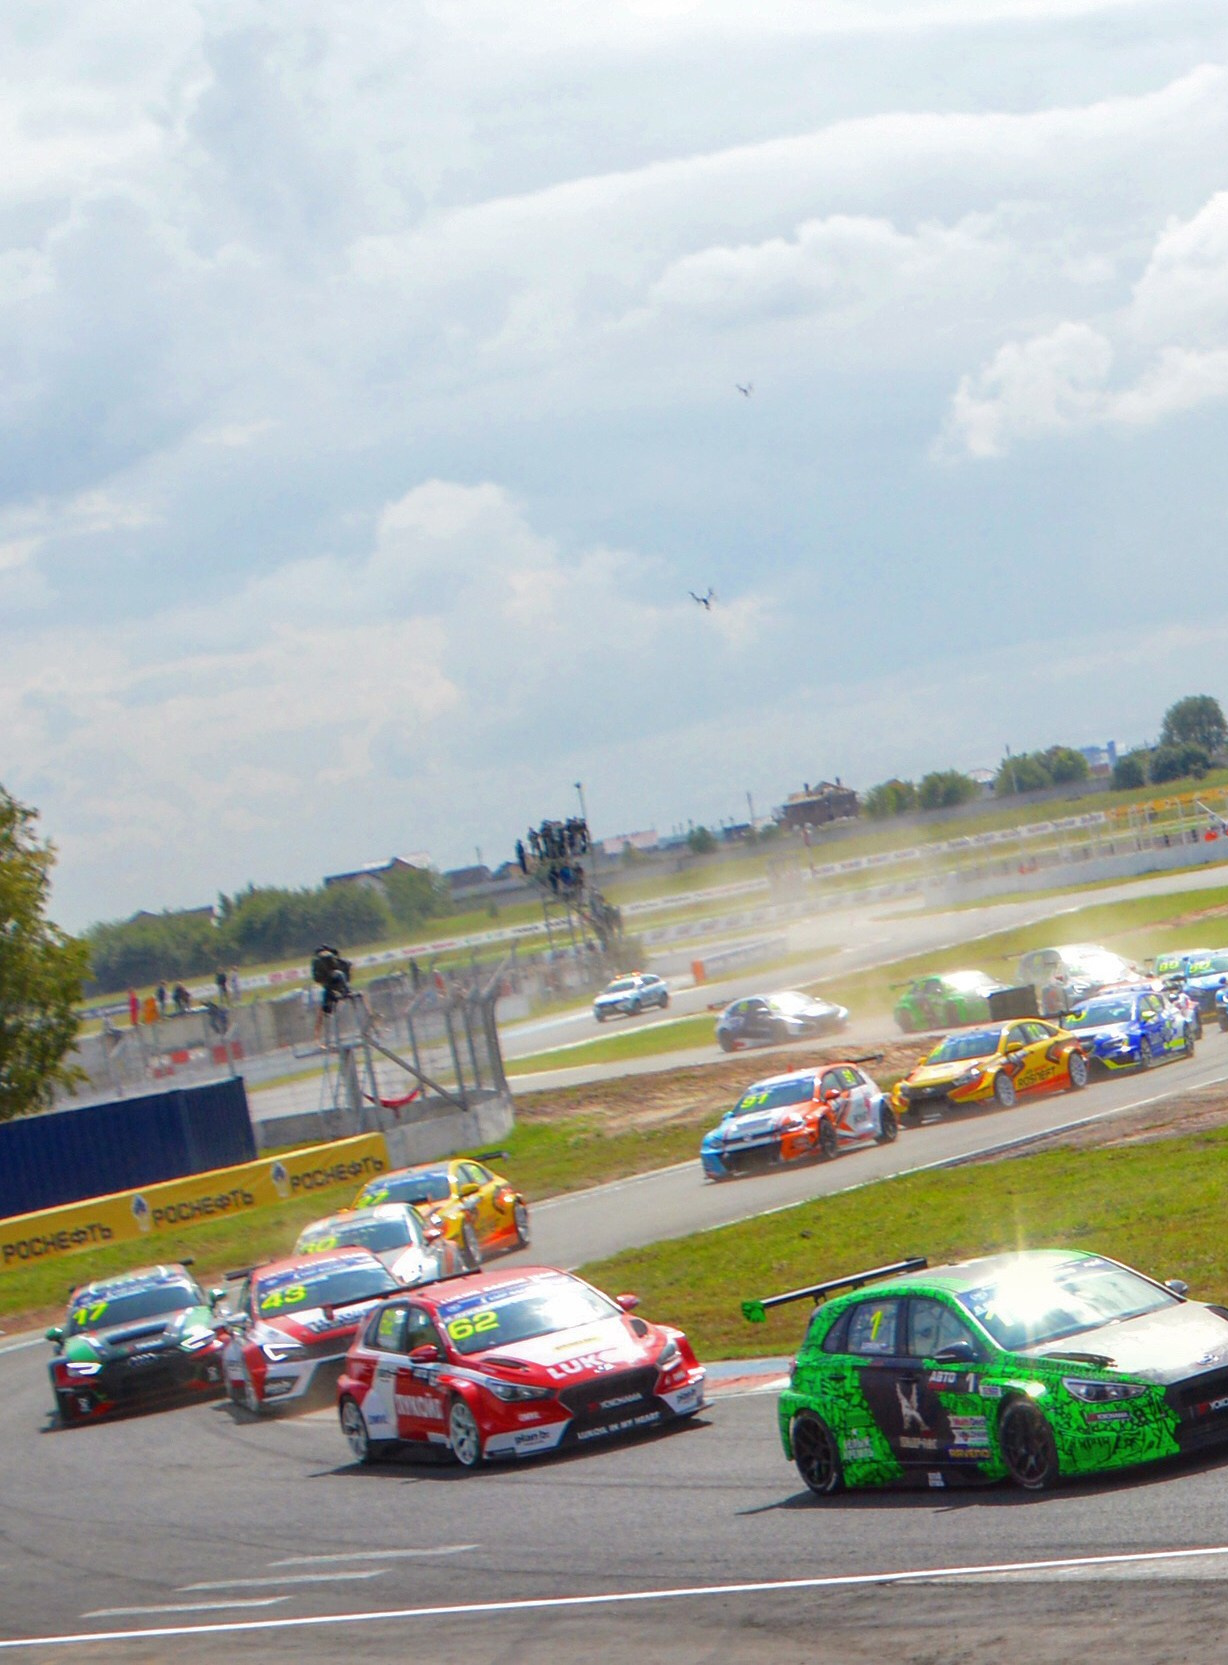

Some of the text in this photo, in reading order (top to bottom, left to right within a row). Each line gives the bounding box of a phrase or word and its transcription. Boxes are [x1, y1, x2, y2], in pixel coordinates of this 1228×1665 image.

[740, 1092, 769, 1110] 91
[290, 1157, 385, 1192] РОСНЕФТЬ
[152, 1189, 255, 1227] РОСНЕФТЬ
[2, 1222, 113, 1263] РОСНЕФТЬ
[261, 1284, 307, 1311] 43
[72, 1301, 110, 1326] 17
[448, 1311, 500, 1341] 62
[870, 1310, 883, 1341] 1
[929, 1370, 957, 1384] АВТО
[965, 1372, 976, 1393] 1
